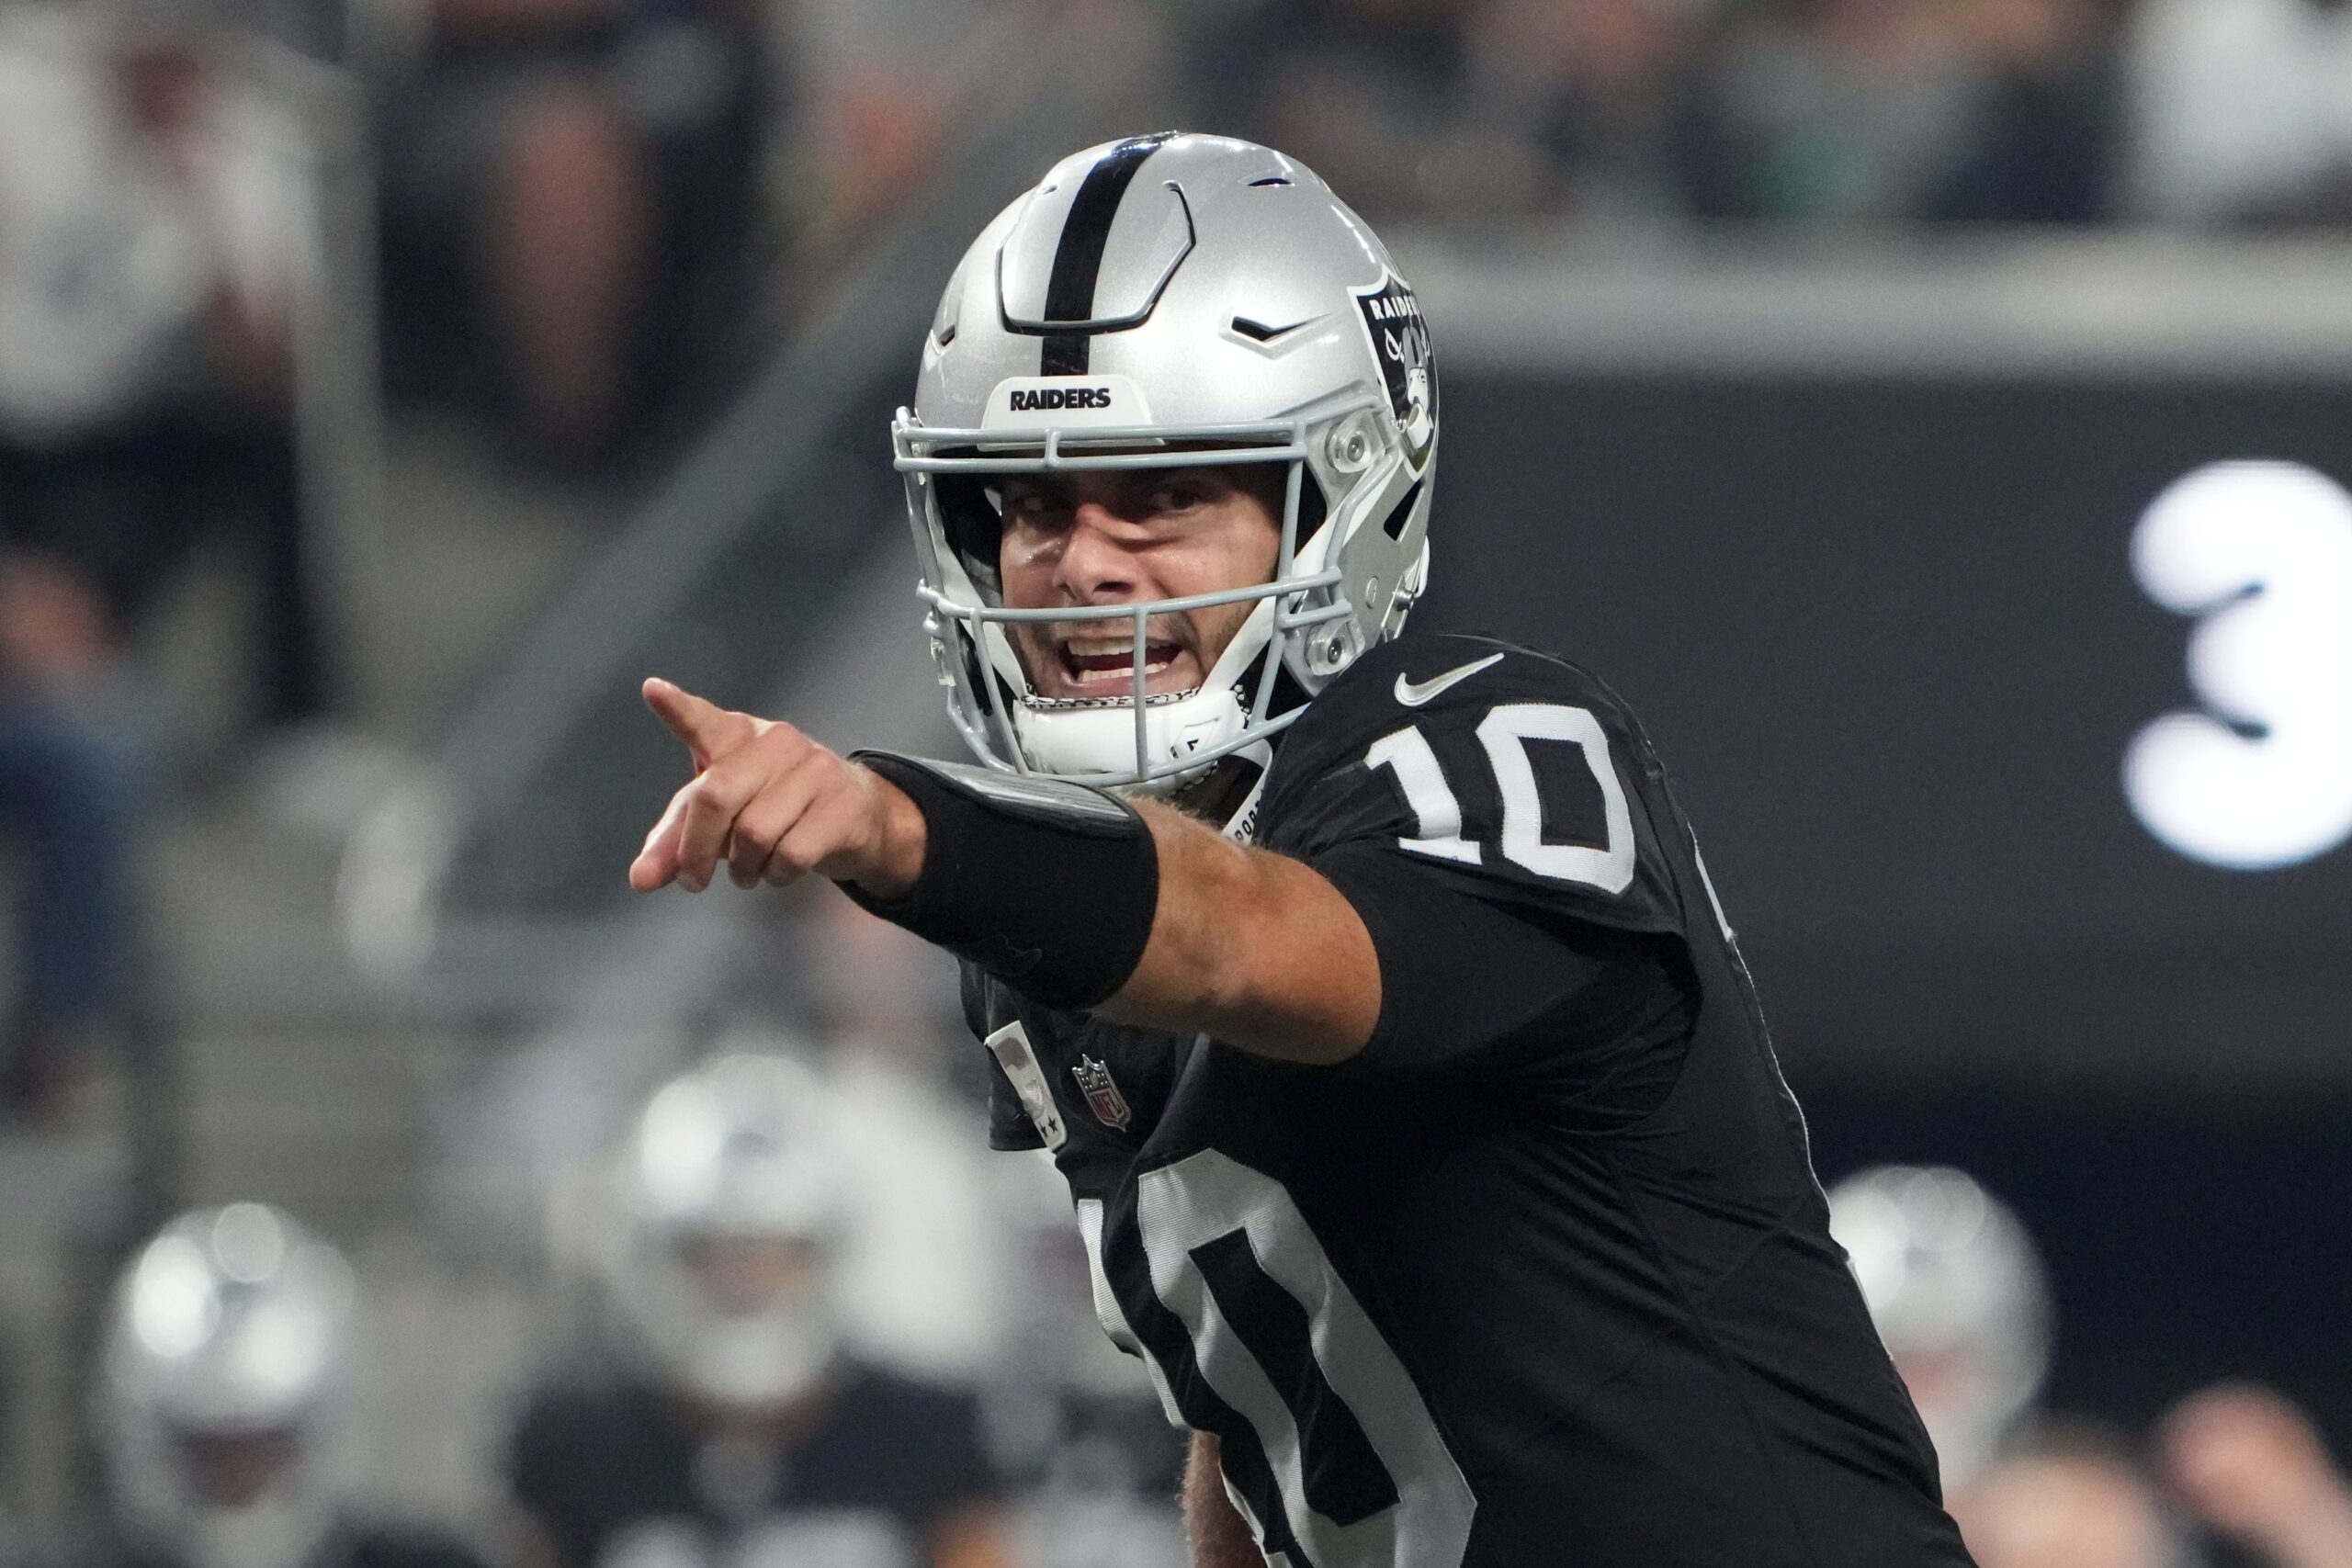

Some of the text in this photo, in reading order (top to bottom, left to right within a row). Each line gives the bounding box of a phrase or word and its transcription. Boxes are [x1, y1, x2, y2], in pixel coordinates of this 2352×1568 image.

[1010, 388, 1112, 412] RAIDERS
[2121, 459, 2352, 871] 3
[1363, 703, 1636, 896] 10
